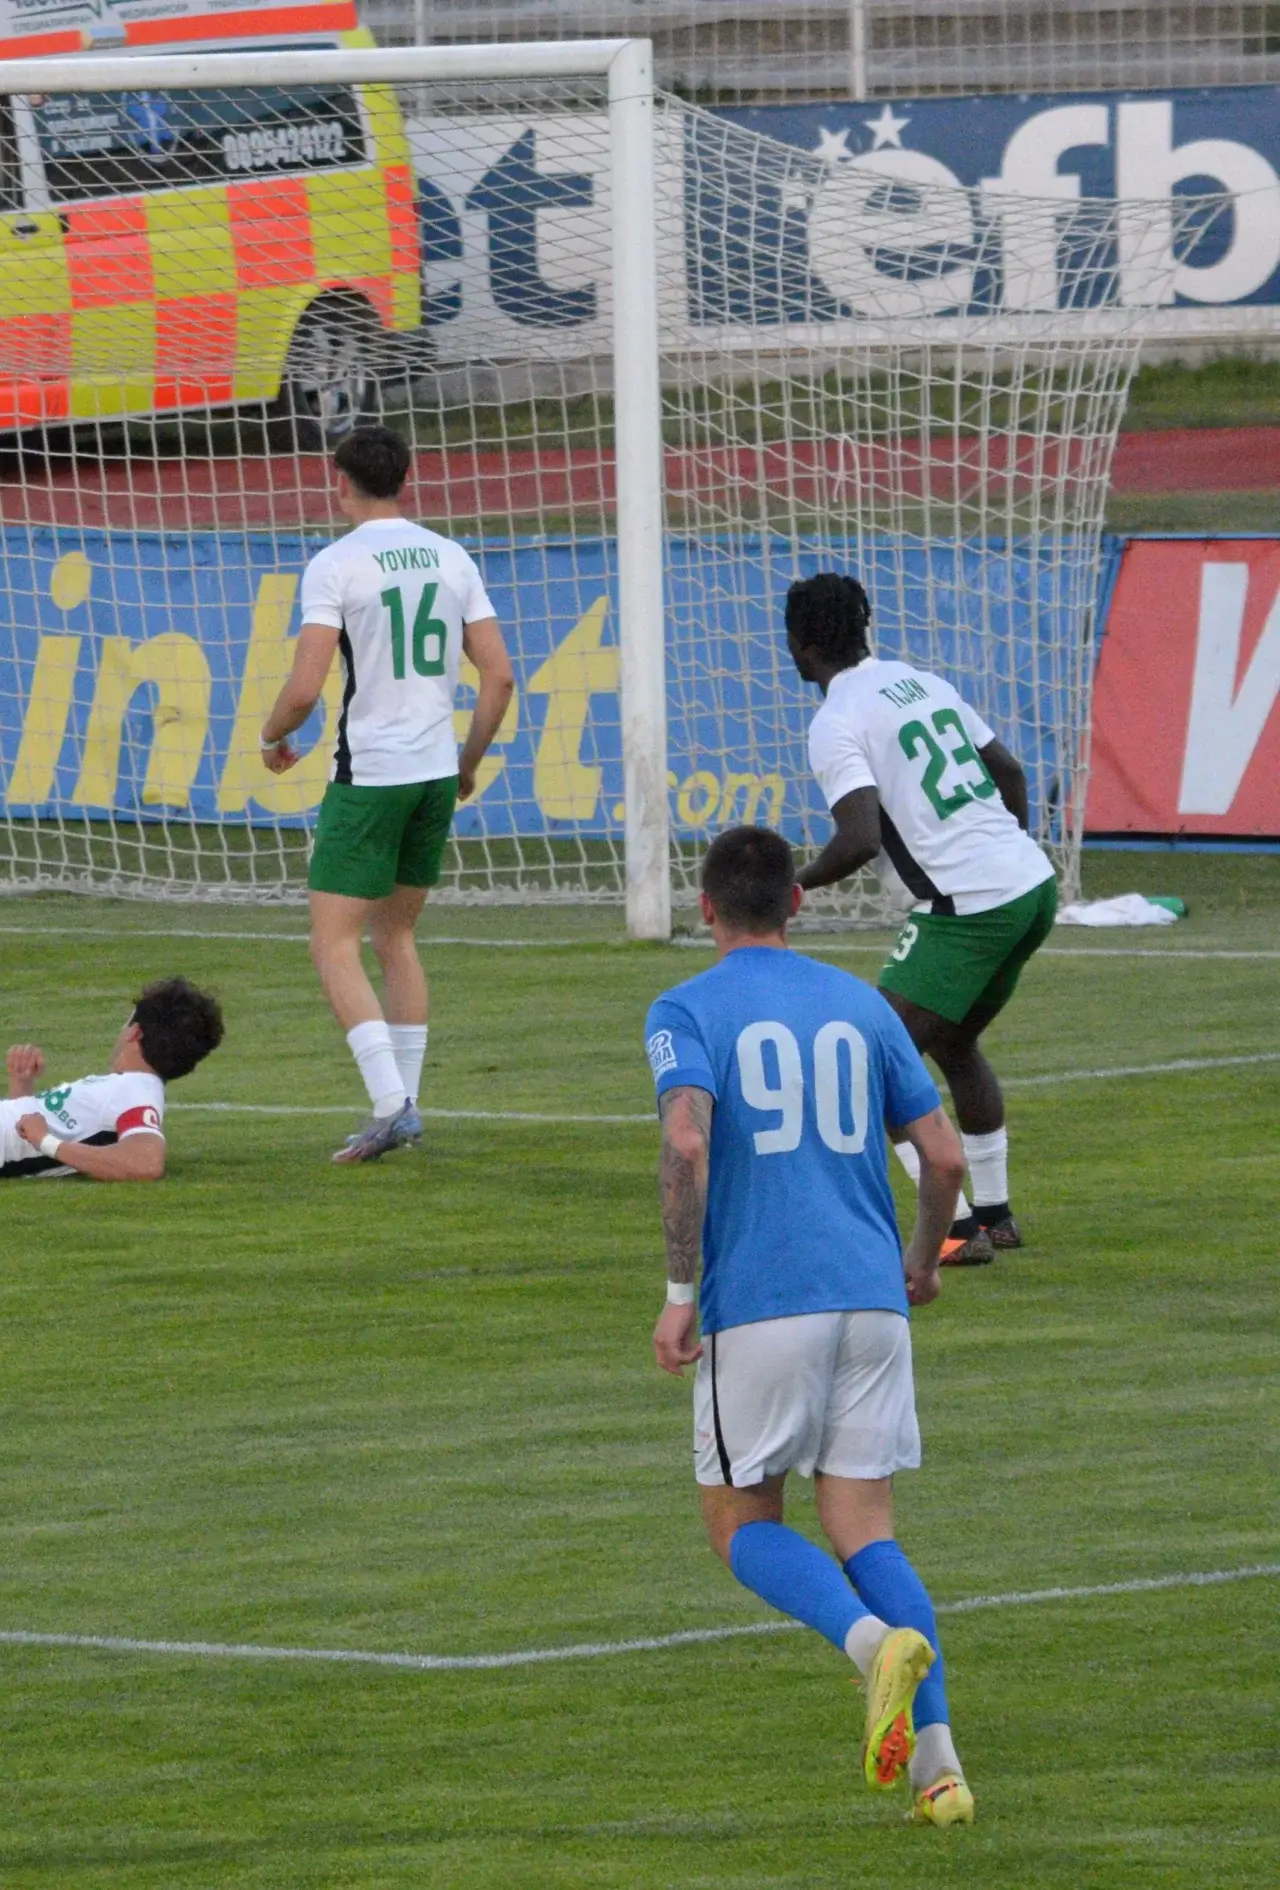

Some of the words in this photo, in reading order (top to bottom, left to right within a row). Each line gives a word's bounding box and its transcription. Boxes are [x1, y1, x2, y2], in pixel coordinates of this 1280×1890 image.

[372, 547, 440, 574] YOVKOV
[380, 582, 447, 680] 16
[878, 678, 930, 708] TIJAN
[898, 708, 996, 821] 23
[736, 1021, 868, 1155] 90
